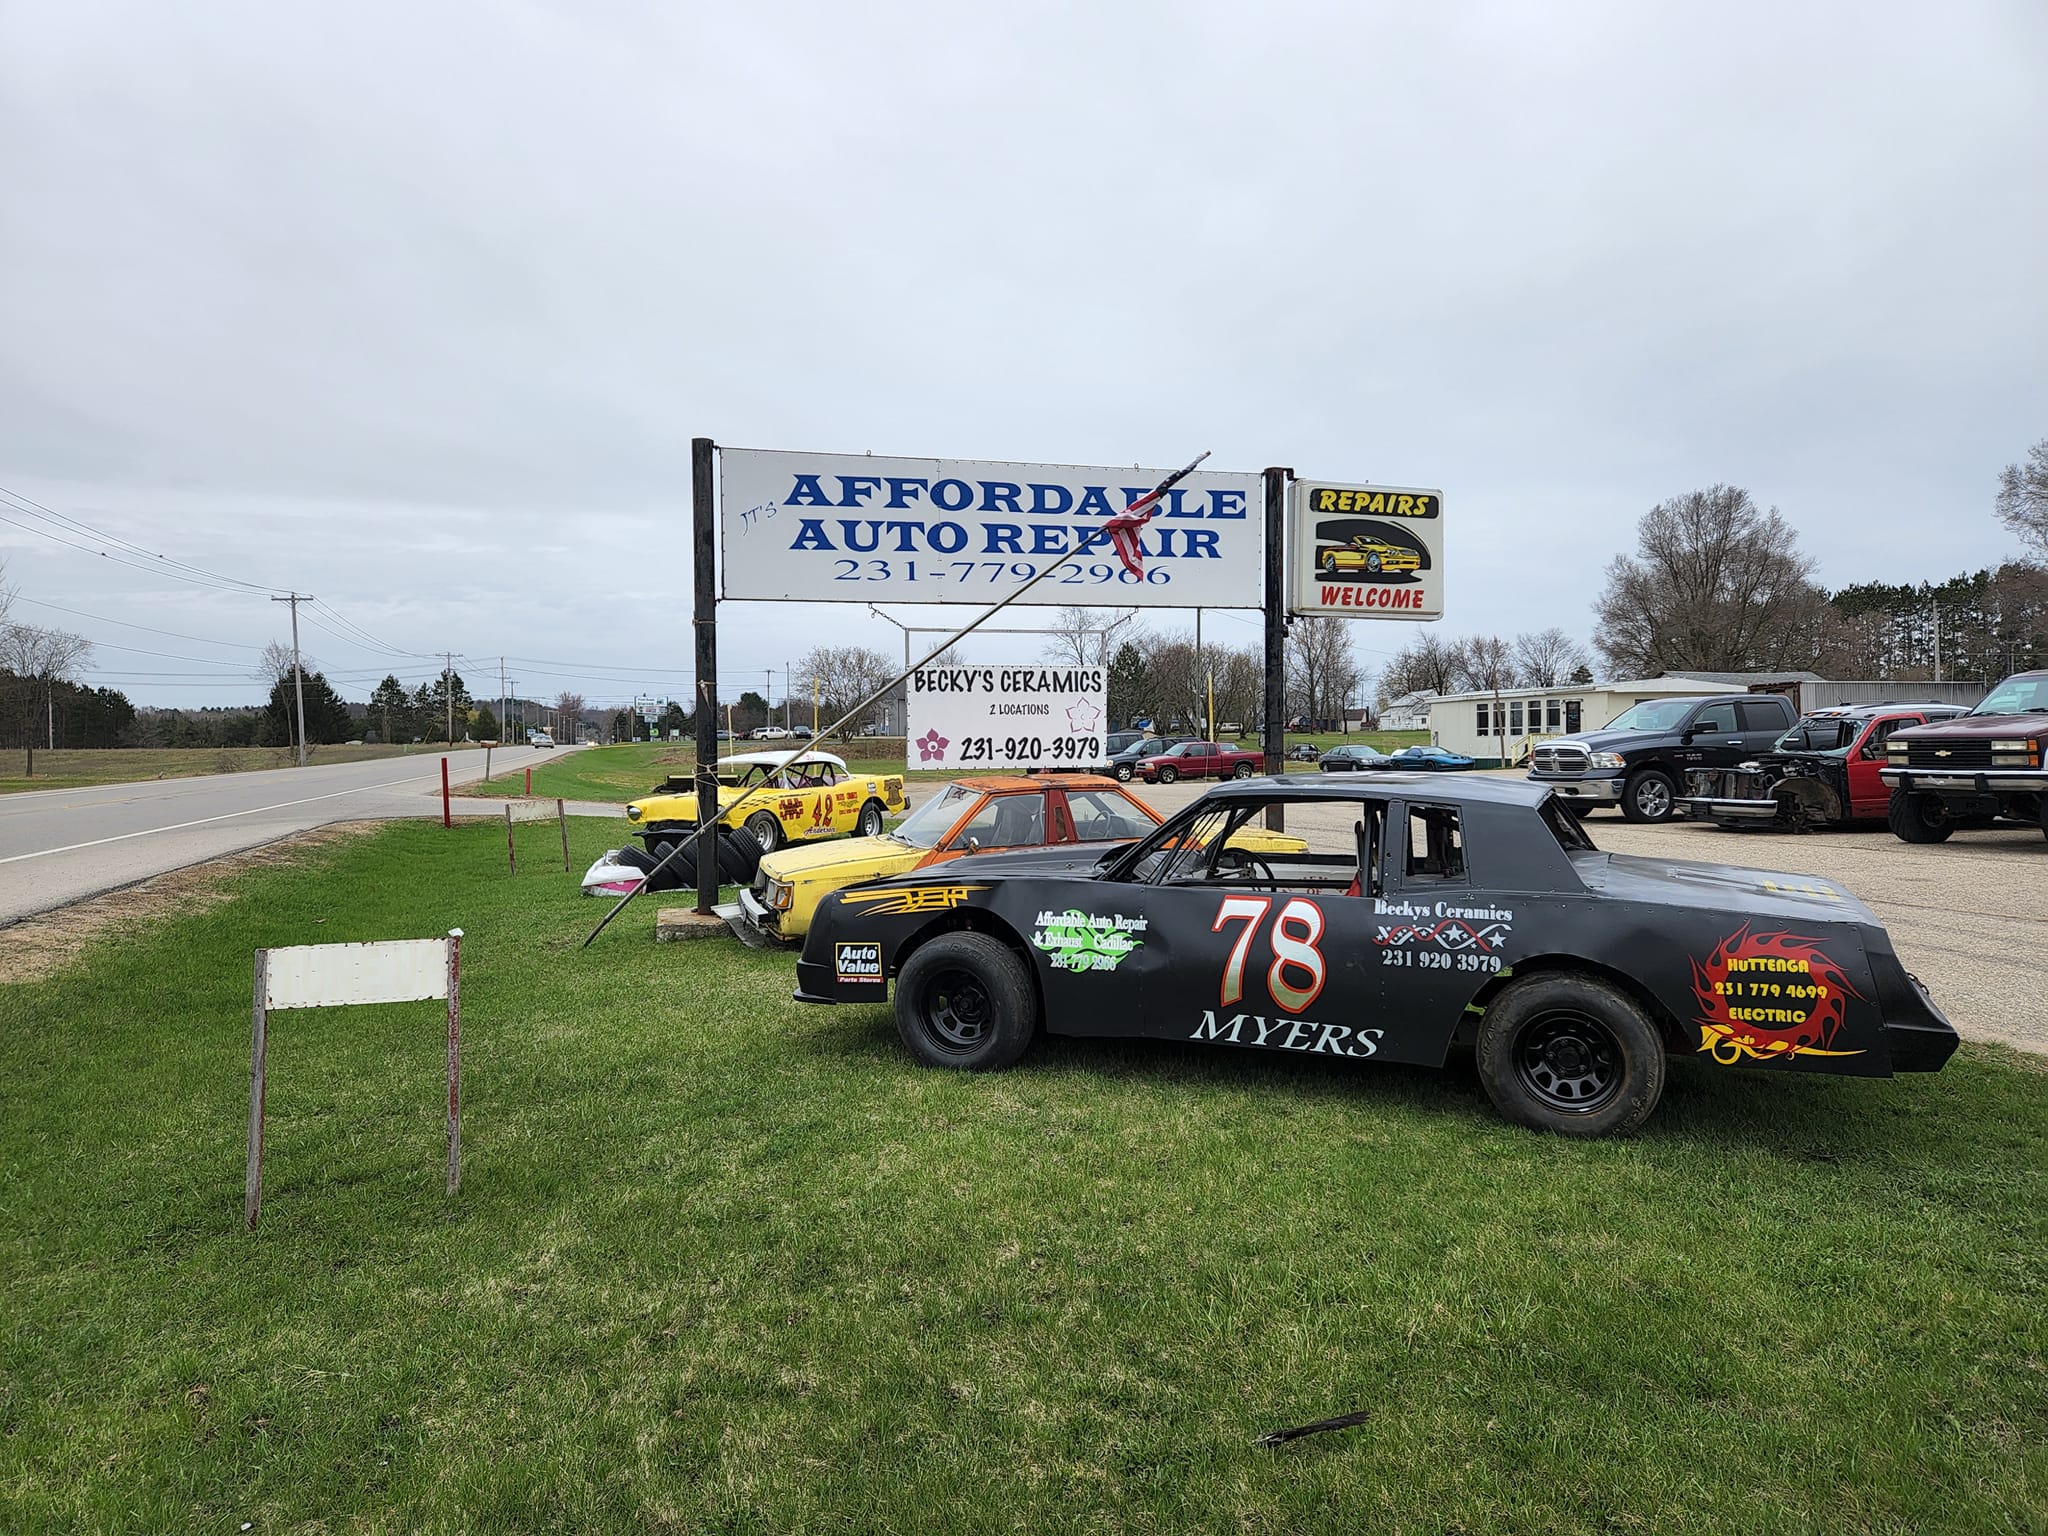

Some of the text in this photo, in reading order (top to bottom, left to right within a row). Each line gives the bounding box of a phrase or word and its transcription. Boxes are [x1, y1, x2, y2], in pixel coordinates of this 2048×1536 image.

[1319, 490, 1430, 516] REPAIRS
[739, 501, 778, 537] JT'S
[788, 518, 969, 553] AUTO
[1320, 585, 1425, 609] WELCOME
[914, 669, 1102, 693] BECKY'S CERAMICS
[989, 704, 1050, 716] 2 LOCATIONS
[959, 737, 1100, 761] 231-920-3979
[811, 793, 834, 828] 42
[1035, 911, 1149, 934] Affordable Auto Repair
[1373, 899, 1513, 922] Beckys Ceramics
[839, 946, 878, 960] Auto
[1033, 931, 1134, 951] & Exhaust Cadillac
[838, 960, 879, 973] Value
[1211, 895, 1326, 1014] 78
[1382, 949, 1501, 973] 231 920 3979
[1714, 982, 1828, 999] 231 779 4699
[1728, 1007, 1807, 1023] ELECTRIC
[1189, 1010, 1385, 1058] MYERS
